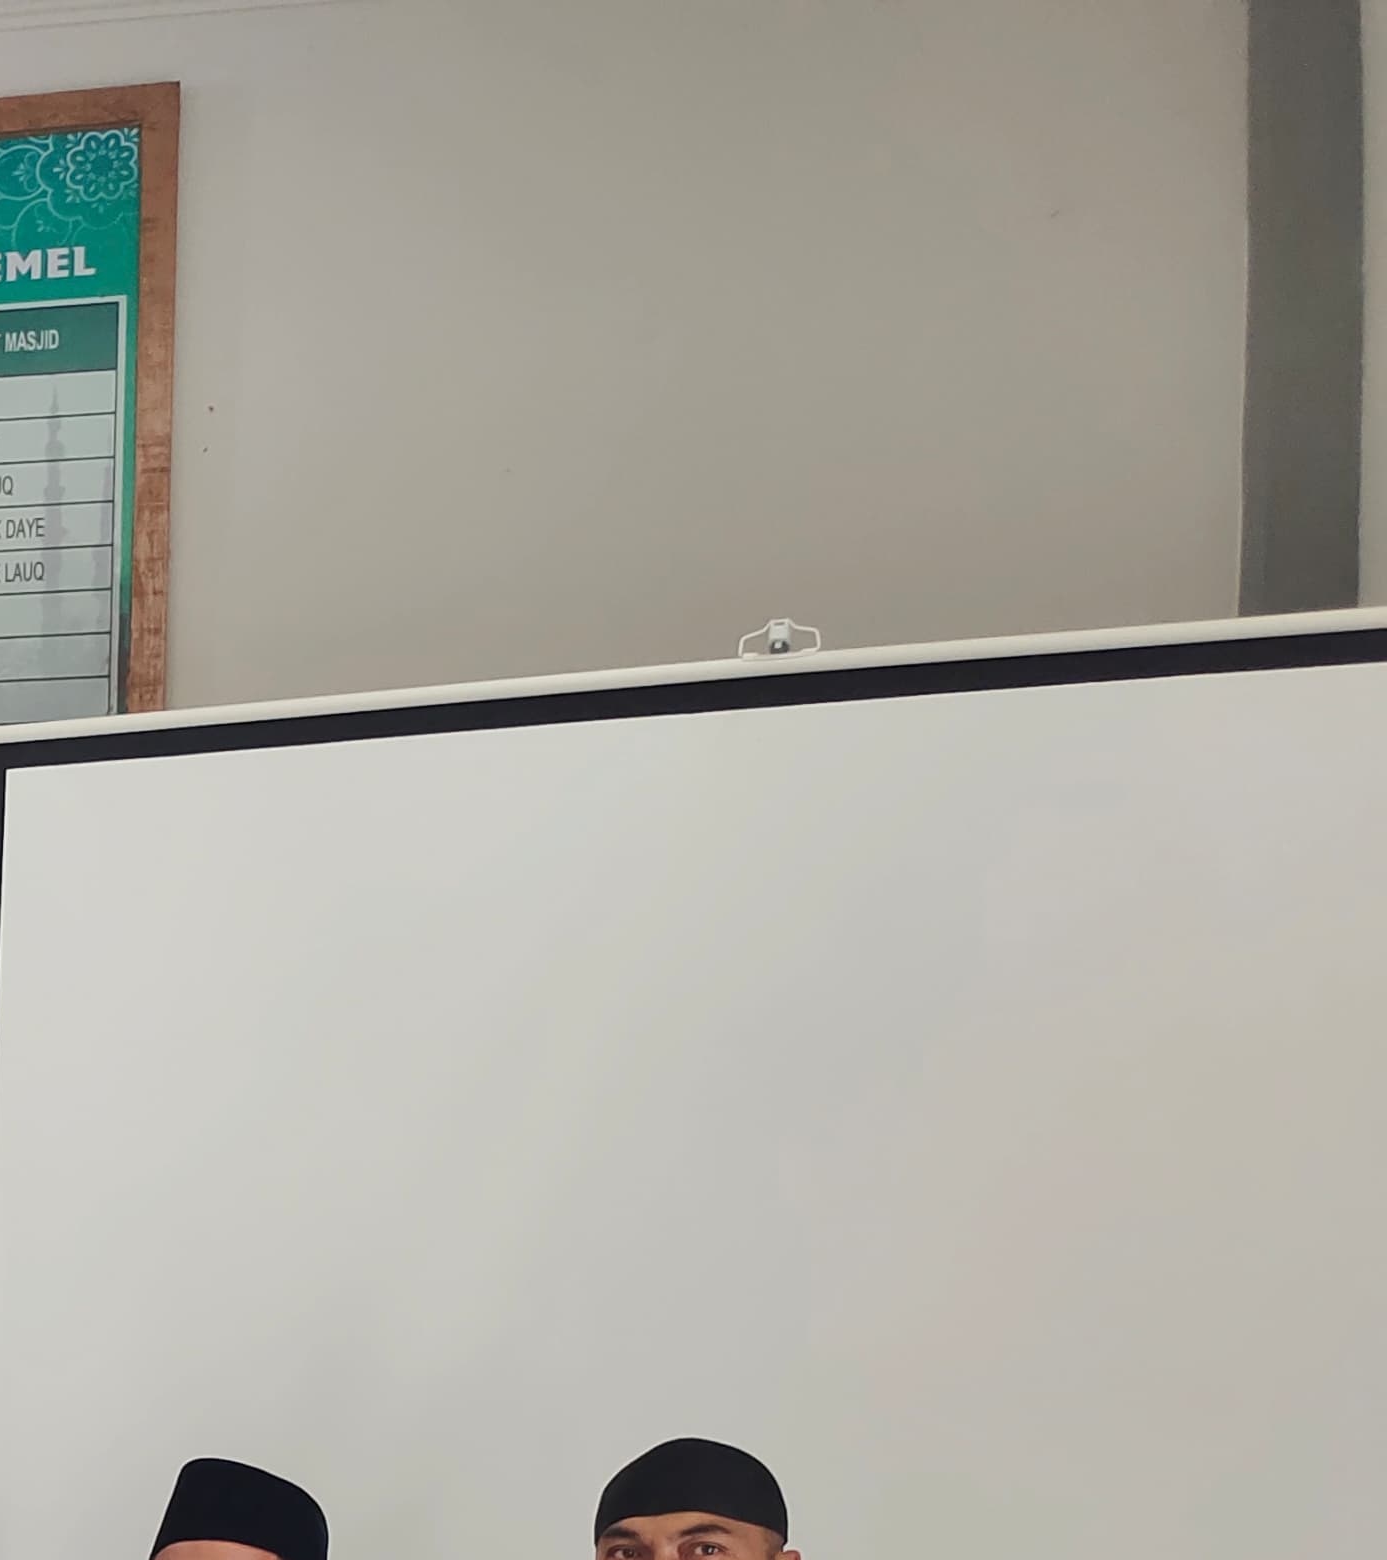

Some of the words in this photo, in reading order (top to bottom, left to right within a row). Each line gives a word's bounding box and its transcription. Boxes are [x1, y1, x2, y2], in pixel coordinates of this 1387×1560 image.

[4, 329, 59, 352] MASJID
[4, 517, 45, 539] DAYE
[4, 561, 44, 583] LAUQ
